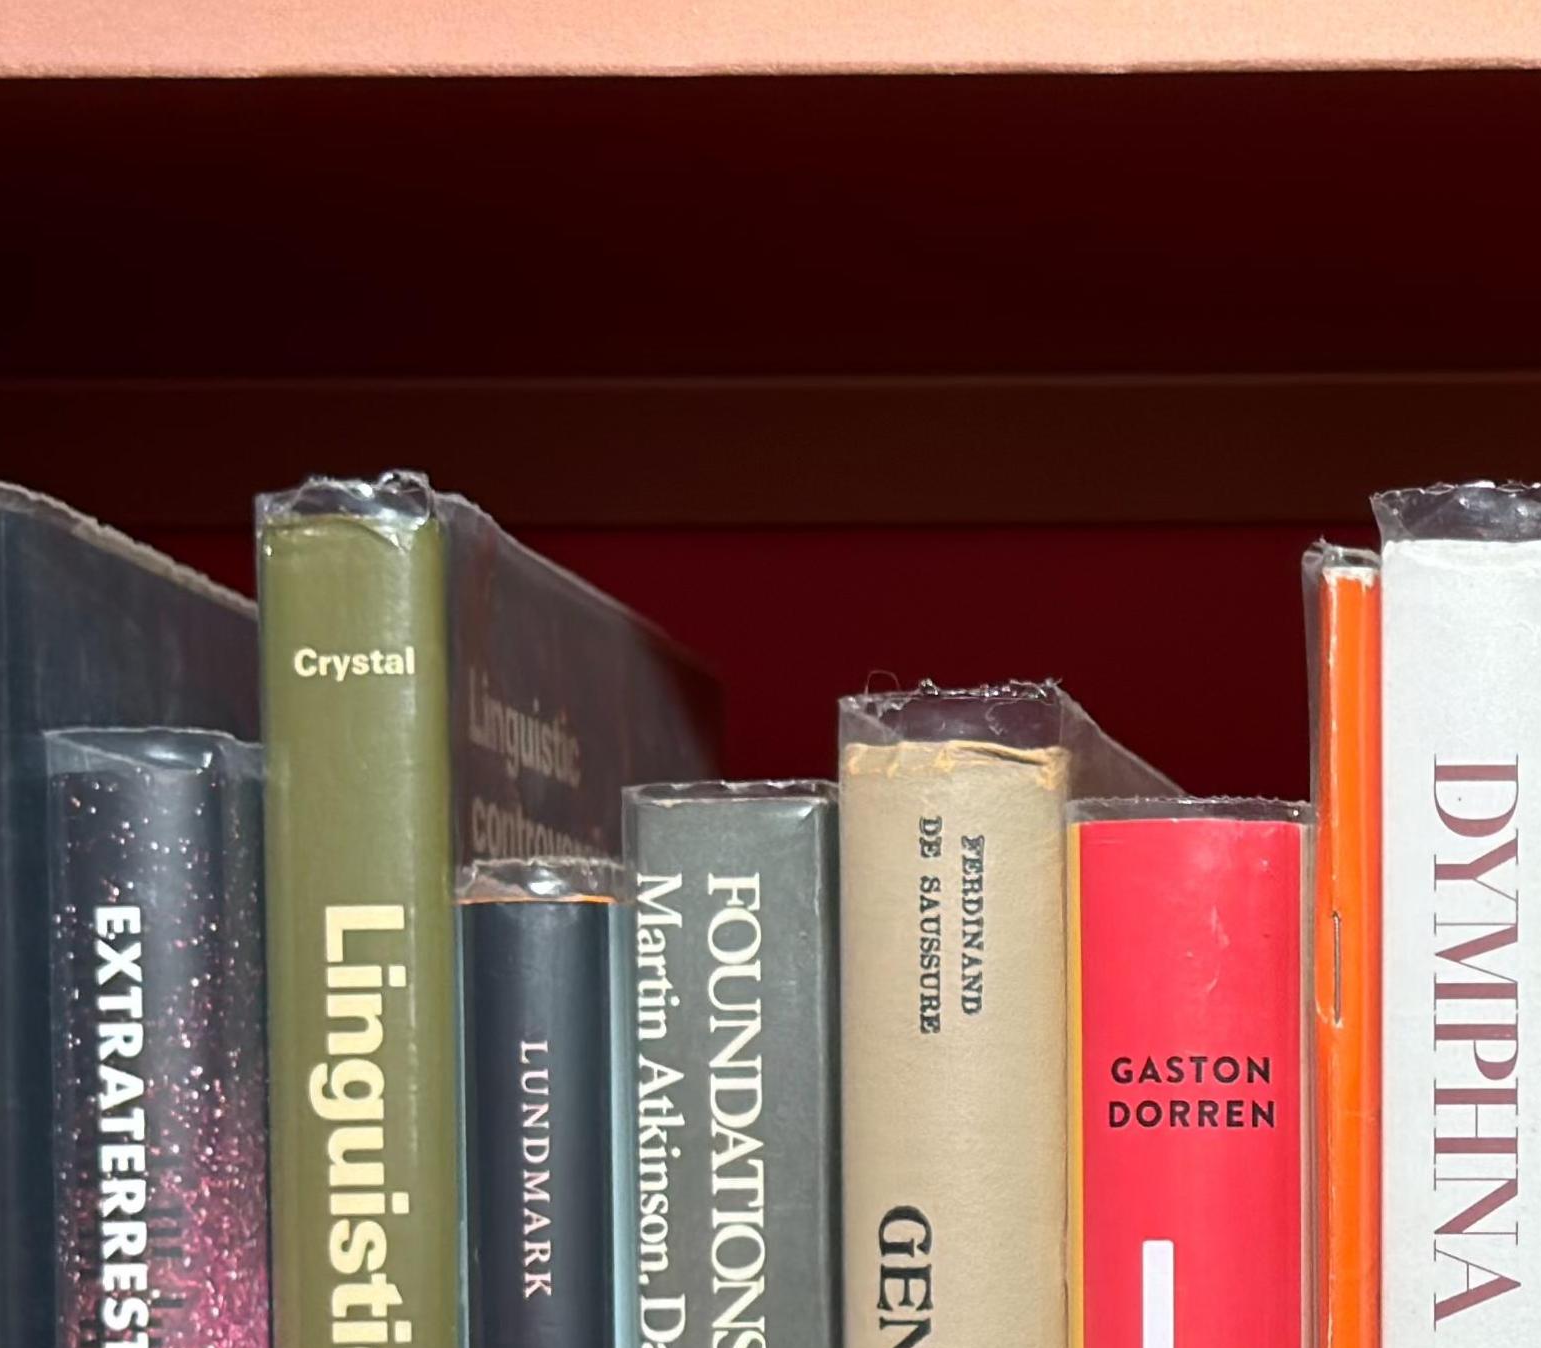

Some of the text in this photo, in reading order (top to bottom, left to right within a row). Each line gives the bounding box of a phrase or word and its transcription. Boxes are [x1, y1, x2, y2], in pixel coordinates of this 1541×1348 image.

[293, 646, 416, 682] Crystal
[637, 873, 683, 1040] Martin
[918, 816, 943, 1034] DE SAUSSURE
[960, 834, 986, 1017] FERDINAND
[1108, 1100, 1276, 1129] DORREN
[1111, 1056, 1271, 1085] GASTON
[1433, 753, 1521, 1331] DYMPHNA
[519, 1040, 552, 1298] LUNDMARK
